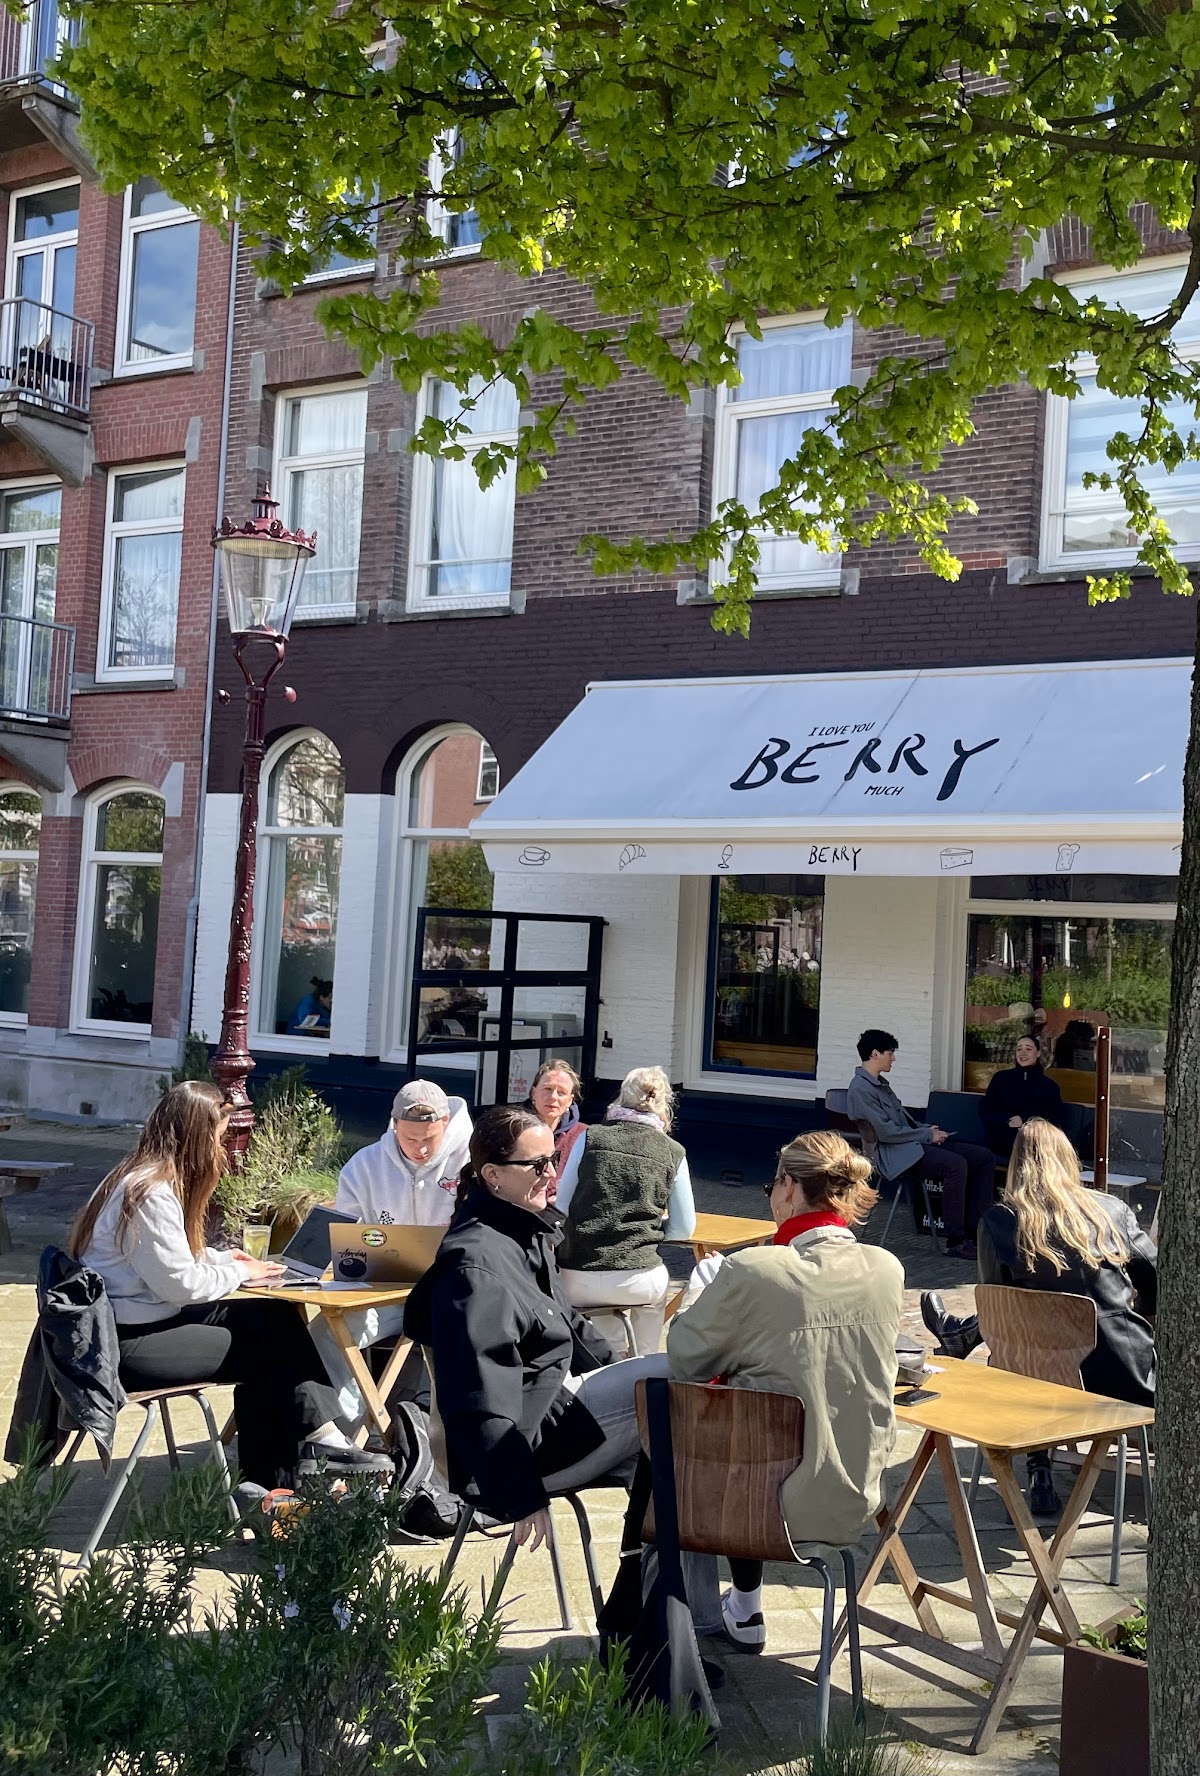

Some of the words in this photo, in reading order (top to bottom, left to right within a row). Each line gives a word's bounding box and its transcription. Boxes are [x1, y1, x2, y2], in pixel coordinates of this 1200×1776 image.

[808, 727, 818, 737] I
[818, 725, 851, 737] LOVE
[851, 721, 876, 734] YOU
[729, 733, 1001, 802] BERRY
[864, 785, 905, 796] MUCH
[808, 845, 862, 872] BERRY
[924, 1179, 944, 1193] fritz-k
[922, 1214, 945, 1229] fri-k
